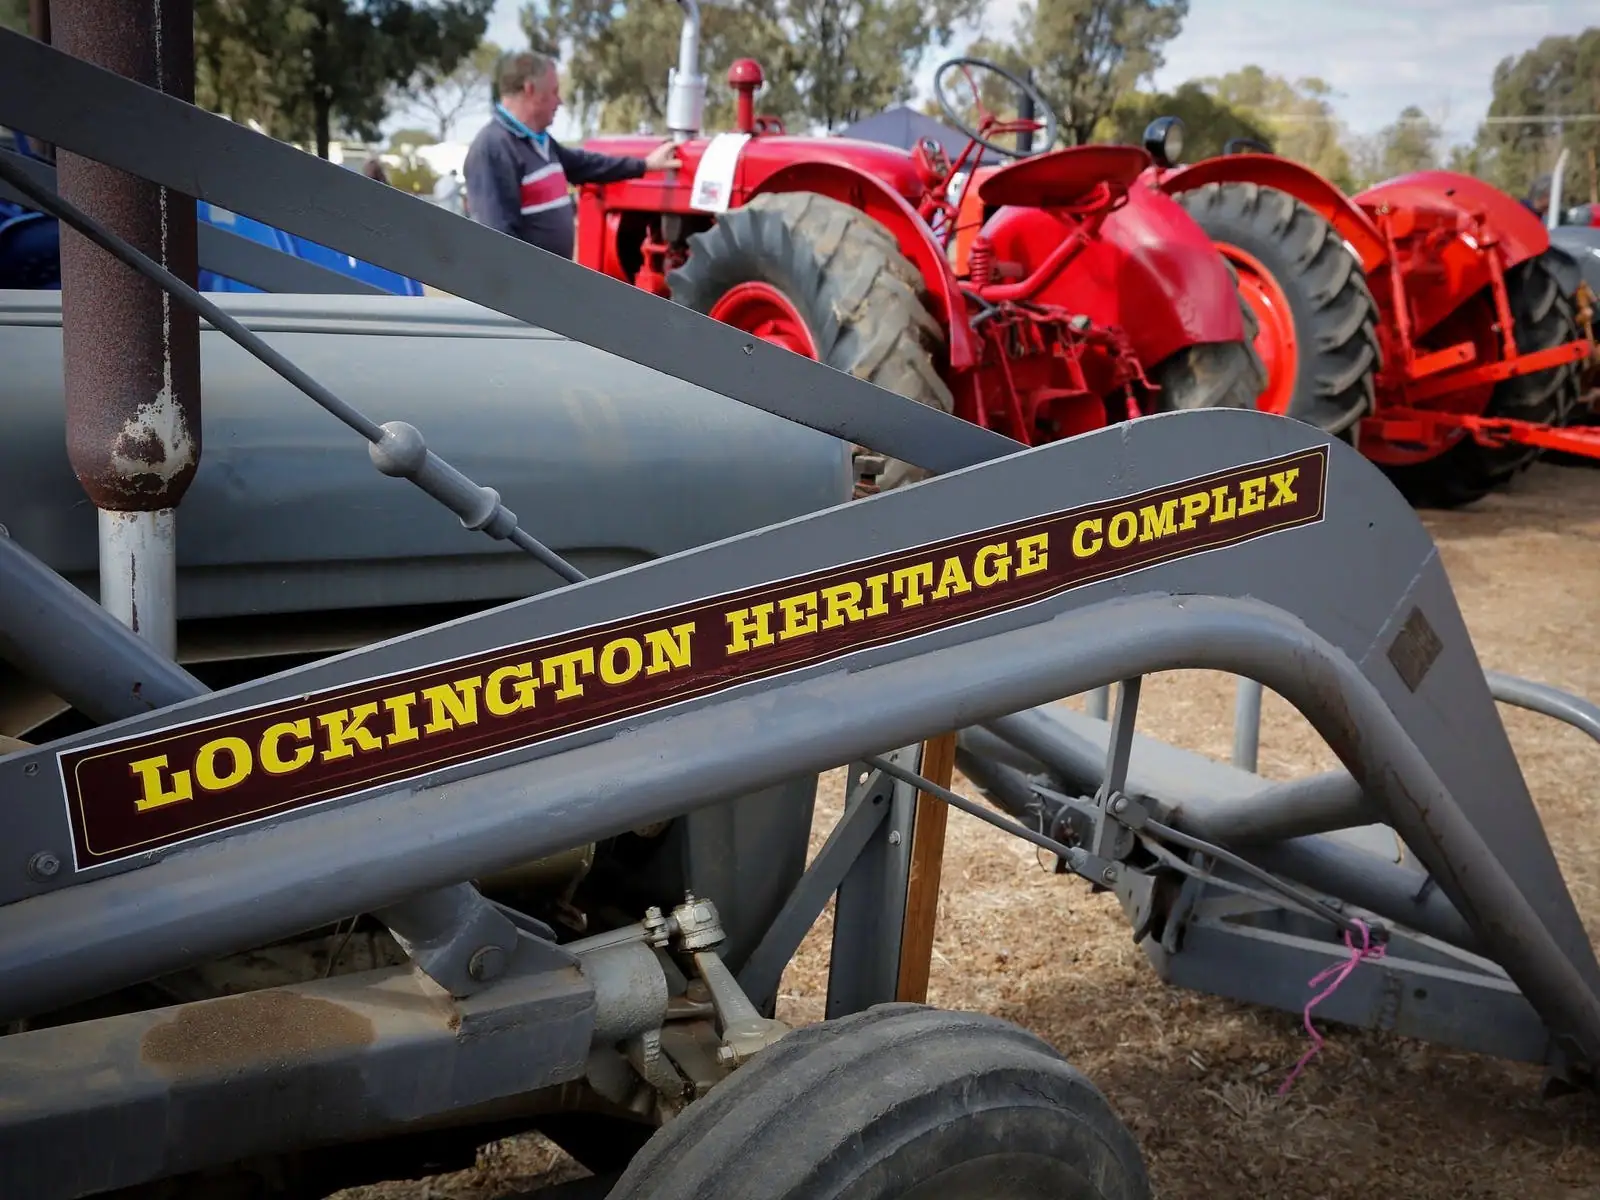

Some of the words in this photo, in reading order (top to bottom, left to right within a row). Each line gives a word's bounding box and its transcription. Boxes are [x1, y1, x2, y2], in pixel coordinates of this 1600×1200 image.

[130, 623, 694, 811] LOCKINGTON
[725, 533, 1049, 654] HERITAGE
[1072, 468, 1299, 557] COMPLEX
